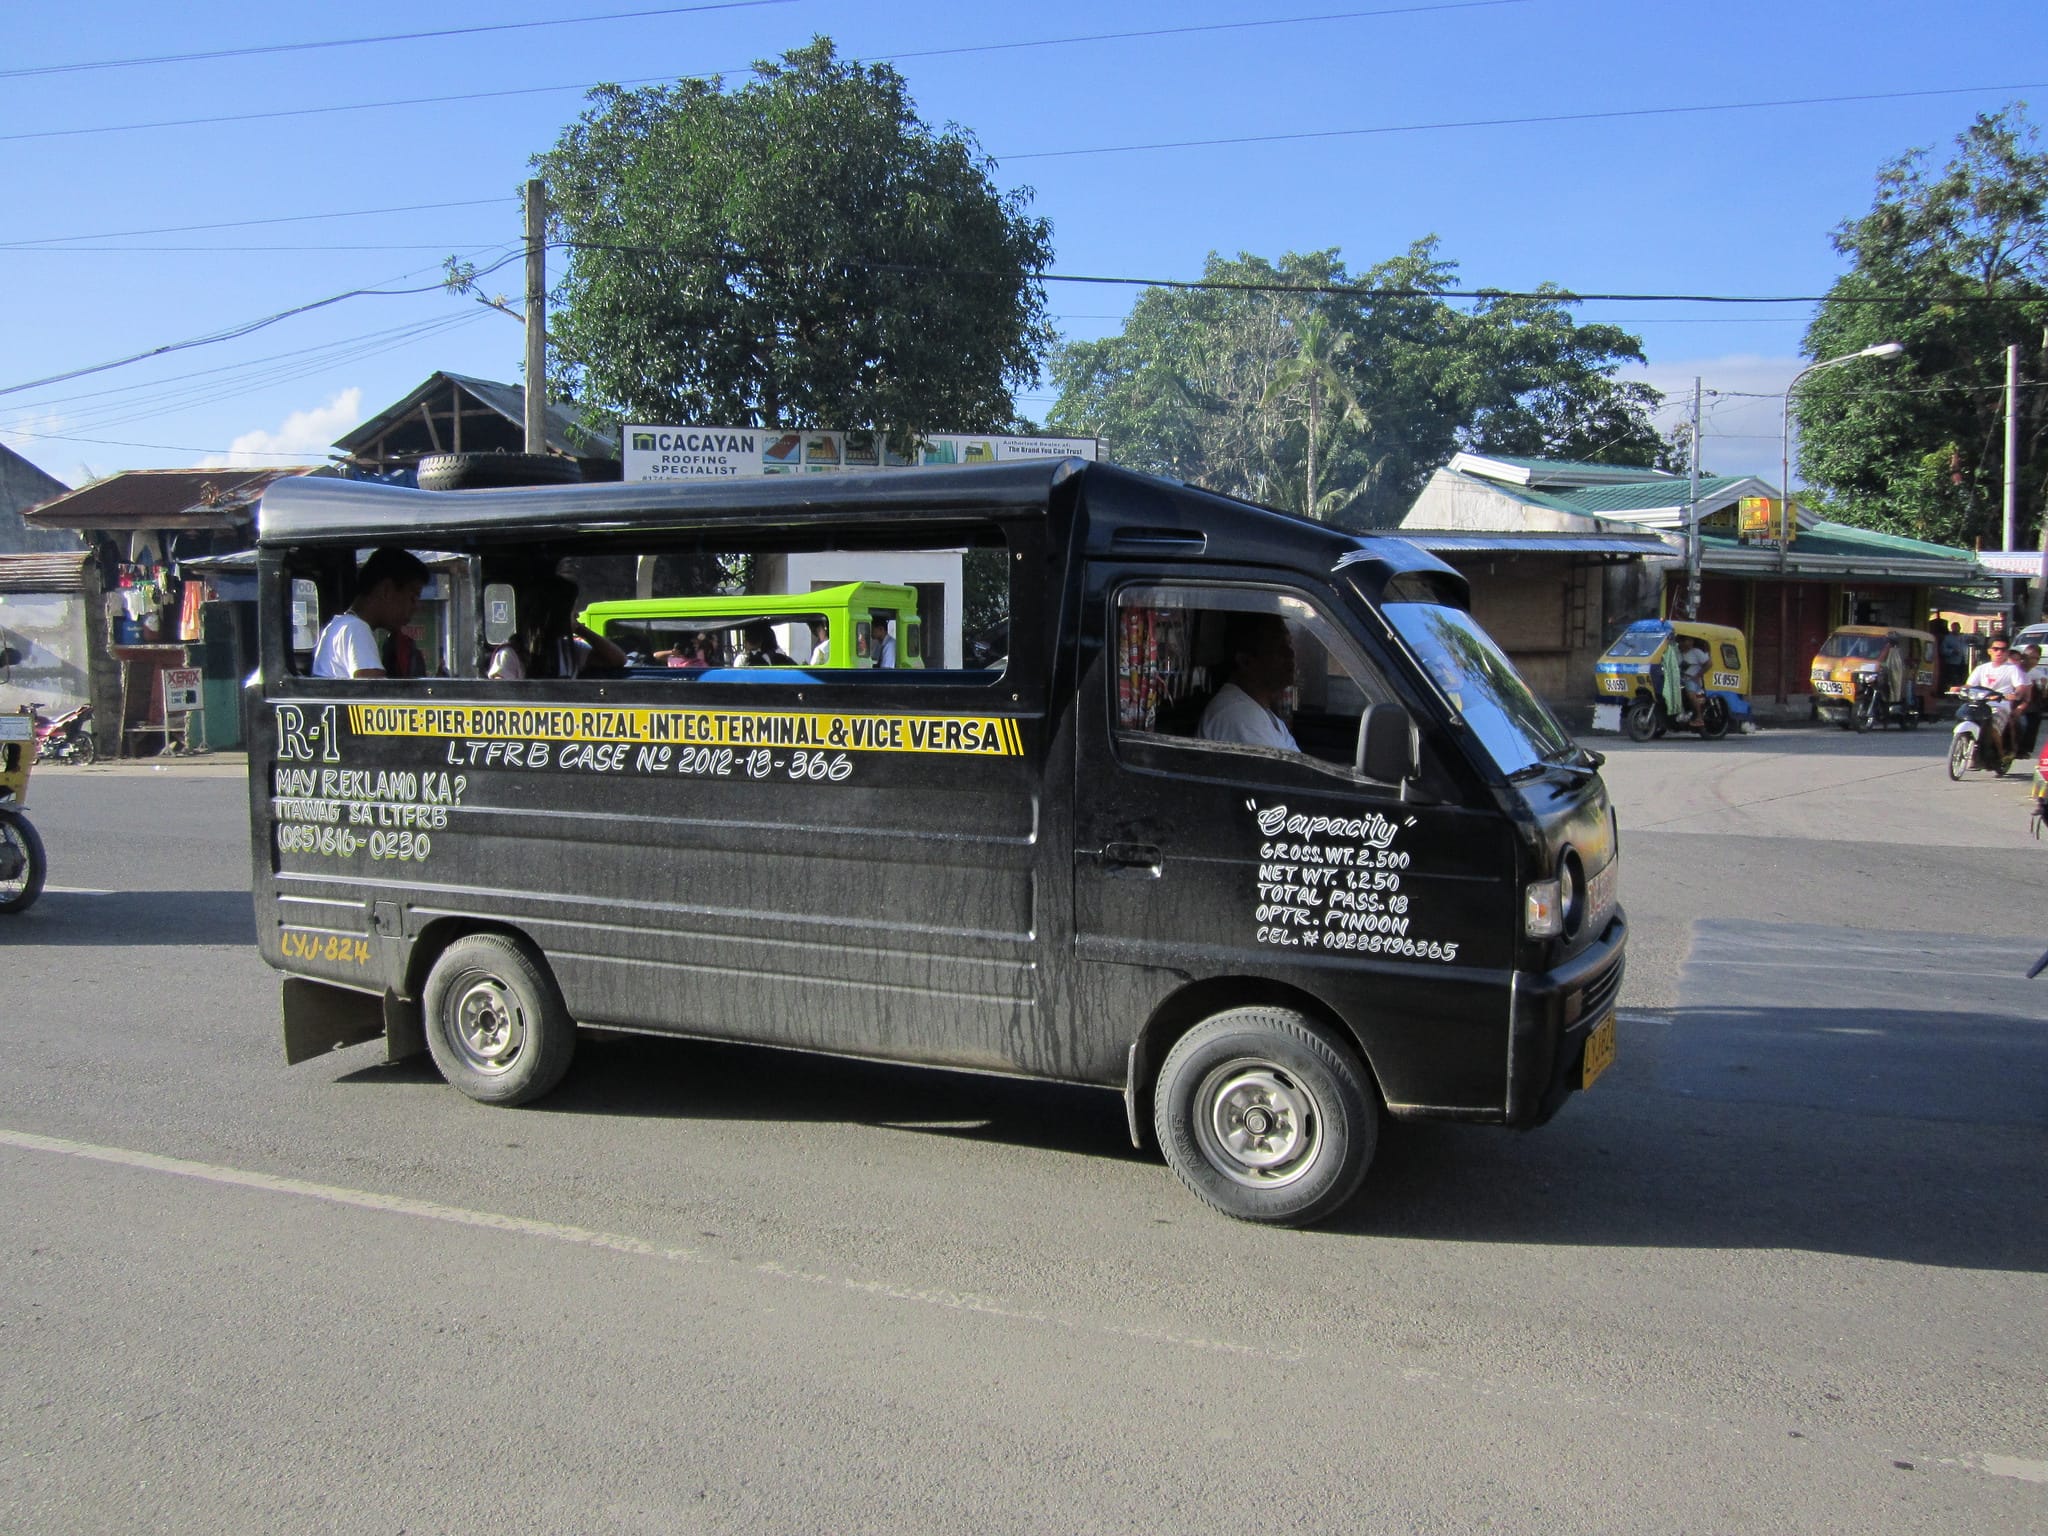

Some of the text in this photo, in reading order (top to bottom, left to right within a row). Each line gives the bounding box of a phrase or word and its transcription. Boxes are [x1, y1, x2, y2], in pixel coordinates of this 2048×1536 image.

[658, 433, 754, 453] CACAYAN
[651, 465, 737, 475] SPECIALIST
[662, 455, 728, 465] ROOFING
[275, 704, 341, 762] R-1
[909, 720, 1001, 751] VERSA
[447, 740, 550, 768] LTFRB
[558, 743, 630, 770] CASE
[275, 768, 467, 807] MAY REKLAMO KA?
[275, 799, 448, 831] ITAWAG SA LTFRB
[1258, 864, 1299, 883] NET
[1302, 868, 1338, 886] WT.
[1257, 883, 1409, 914] TOTAL PASS. 18
[1256, 904, 1320, 926] OPTR.
[1256, 926, 1299, 945] CEL.
